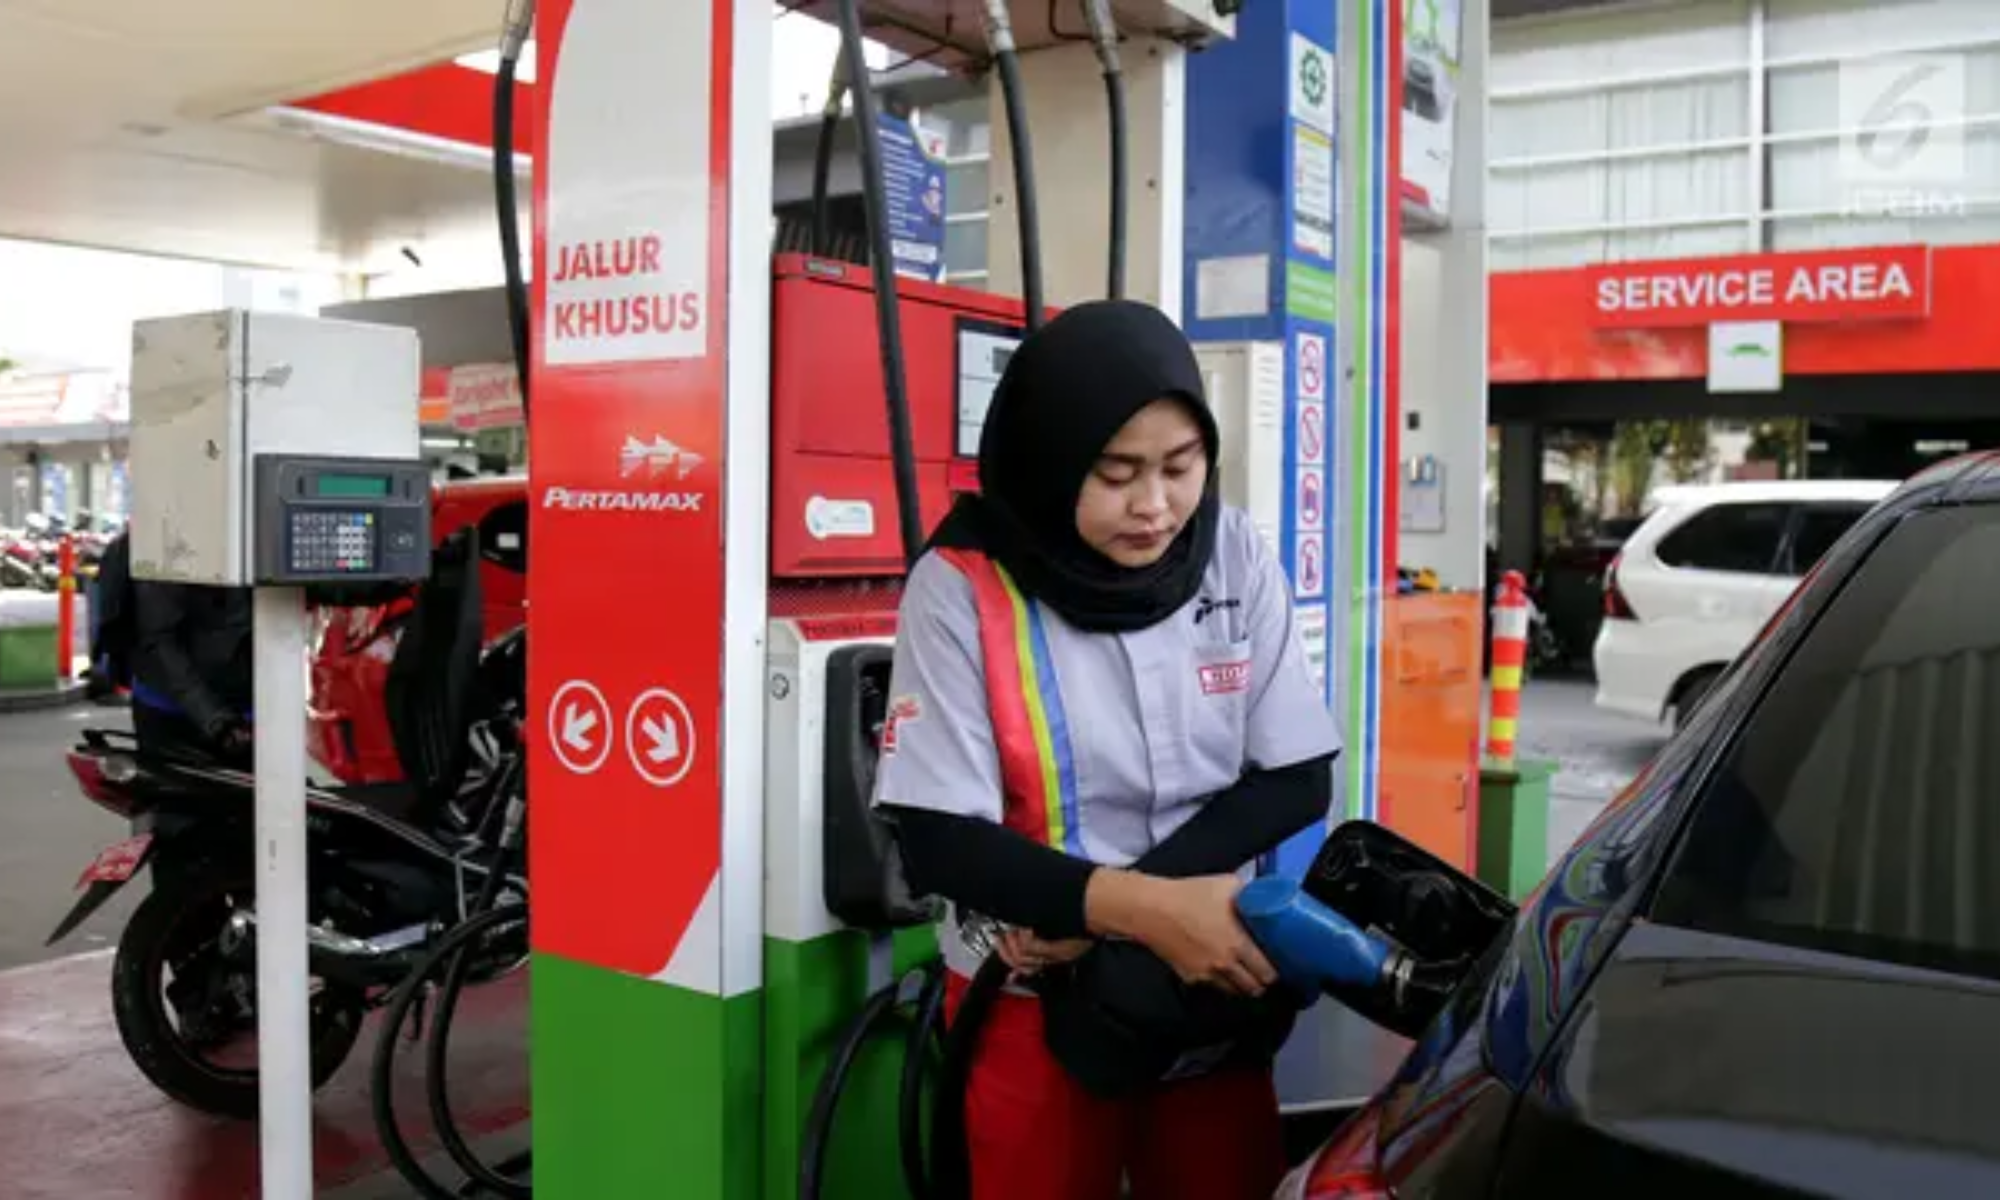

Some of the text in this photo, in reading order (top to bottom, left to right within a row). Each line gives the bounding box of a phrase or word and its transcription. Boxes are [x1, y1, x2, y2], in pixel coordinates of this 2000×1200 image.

[553, 234, 661, 281] JALUR
[1596, 262, 1912, 311] SERVICE AREA
[555, 292, 700, 339] KHUSUS
[541, 486, 704, 511] PERTAMAX
